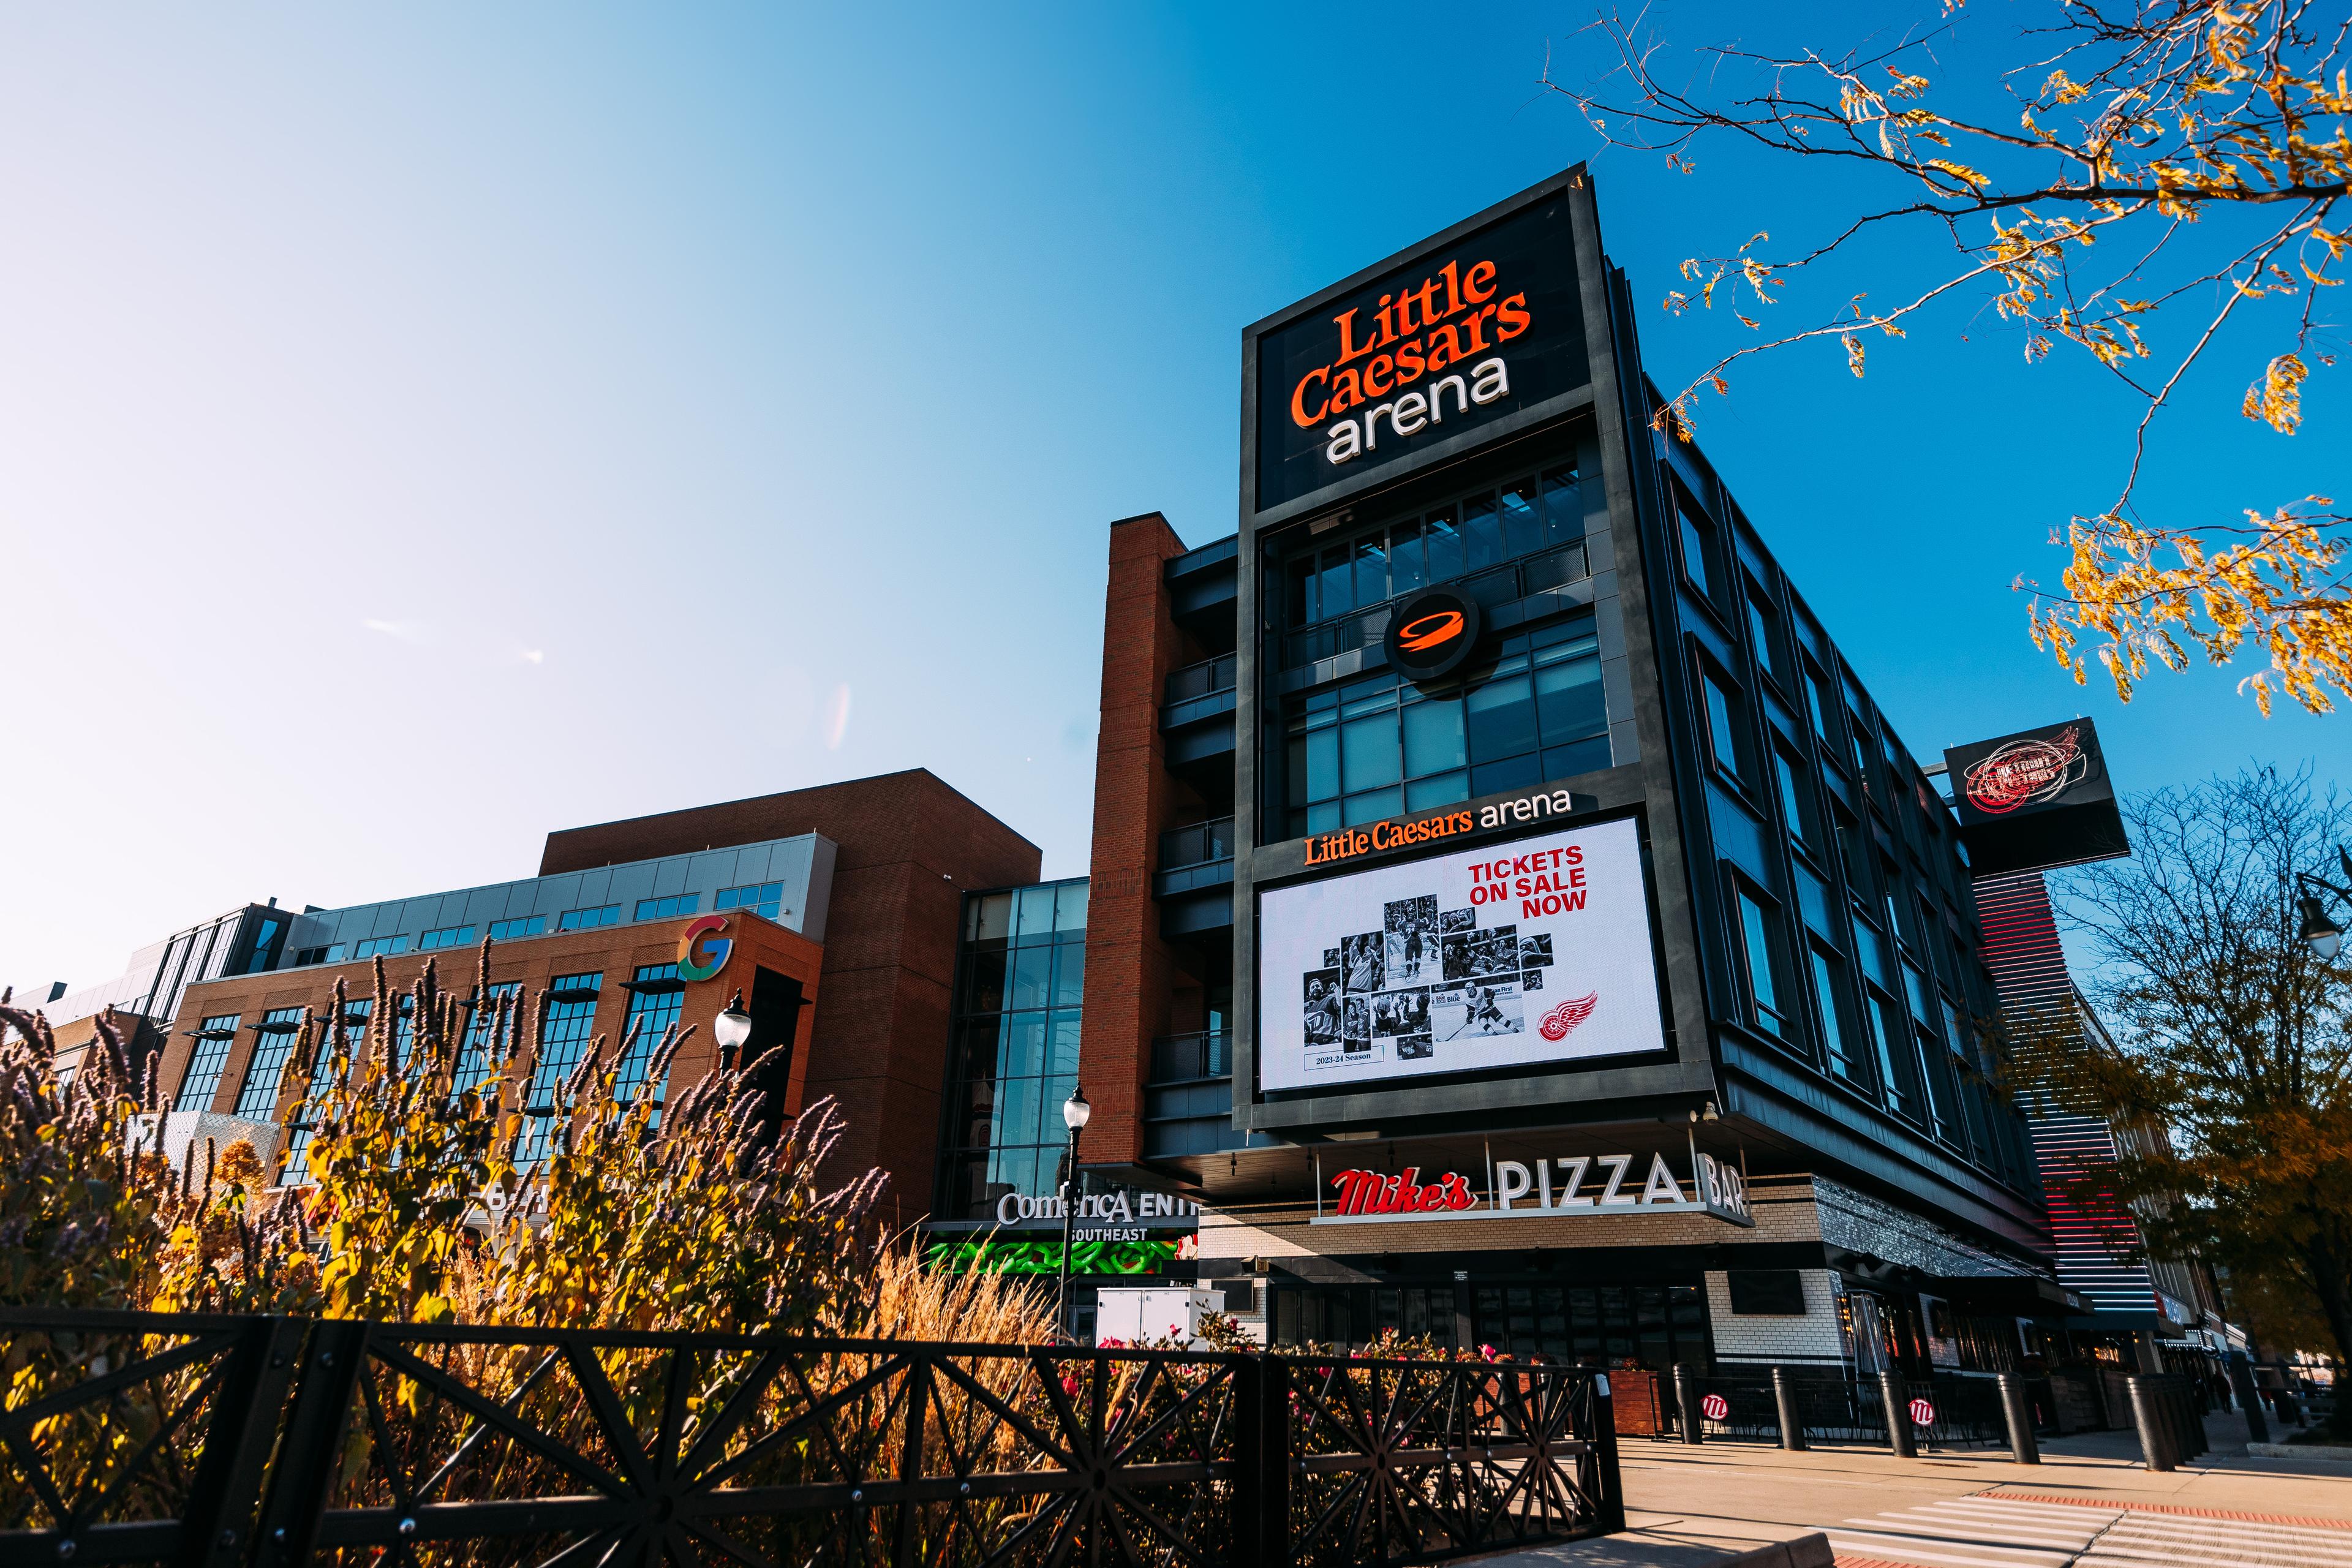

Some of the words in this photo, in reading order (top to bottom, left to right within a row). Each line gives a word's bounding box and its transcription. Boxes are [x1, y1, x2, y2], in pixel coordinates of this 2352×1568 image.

[1333, 259, 1498, 368] Little
[1291, 292, 1531, 429] Caesars
[1326, 357, 1510, 465] arena
[1304, 829, 1368, 866] Little
[1372, 810, 1473, 851] Caesars
[1480, 790, 1572, 828] arena
[1468, 845, 1583, 883] TICKETS
[1470, 881, 1507, 905] ON
[1515, 867, 1586, 897] SALE
[1522, 889, 1587, 919] NOW
[677, 915, 734, 981] G
[1316, 1055, 1343, 1065] 2023-24
[1345, 1053, 1371, 1061] Season
[1330, 1167, 1479, 1215] Mike's
[1496, 1152, 1687, 1210] PIZZA
[1697, 1153, 1747, 1217] BAR
